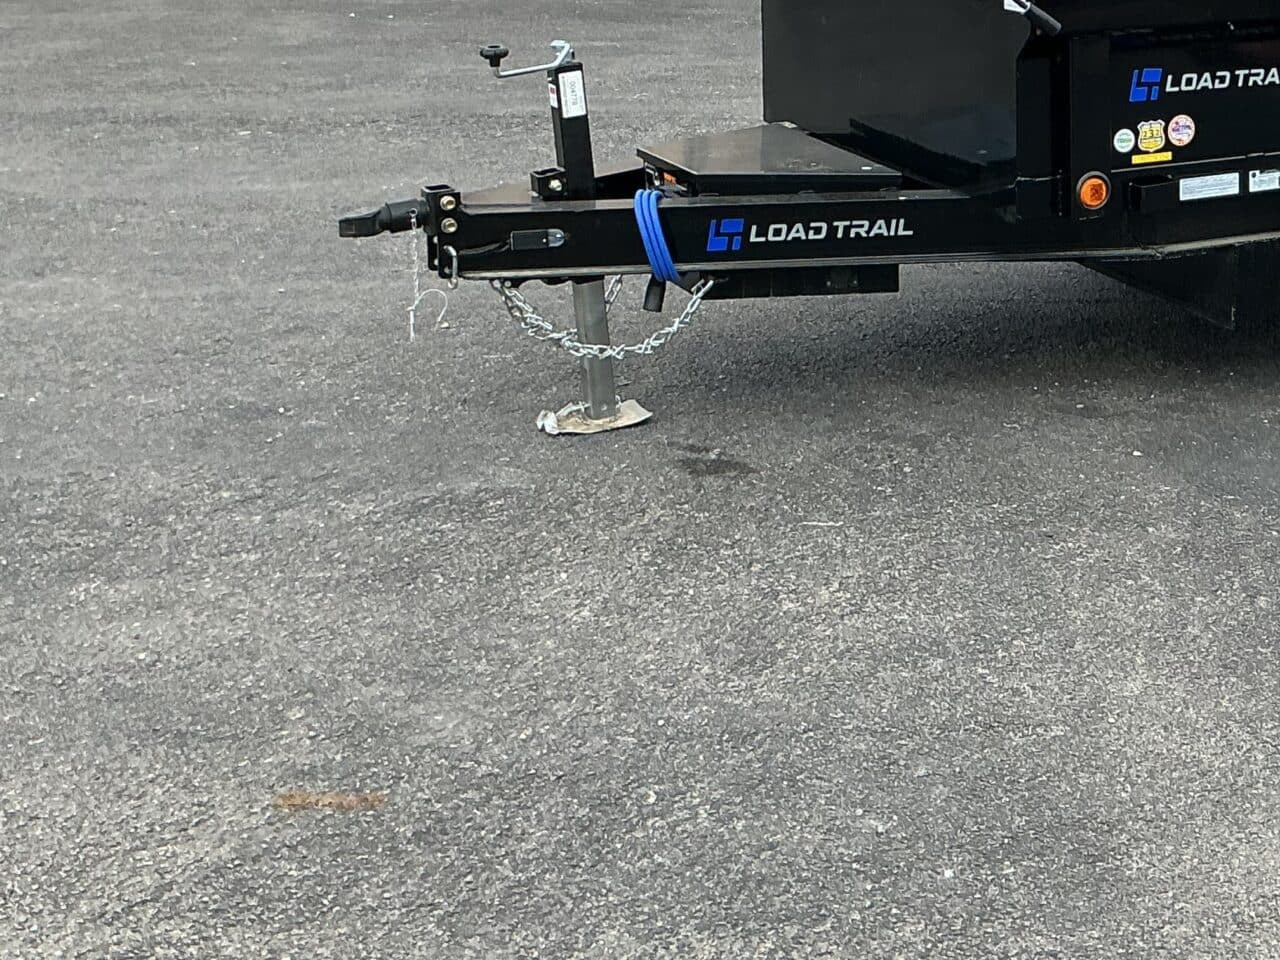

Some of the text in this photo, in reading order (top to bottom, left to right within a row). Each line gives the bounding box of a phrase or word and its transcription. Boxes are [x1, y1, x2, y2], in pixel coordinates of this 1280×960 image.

[1165, 71, 1231, 93] LOAD
[749, 218, 914, 243] LOAD TRAIL
